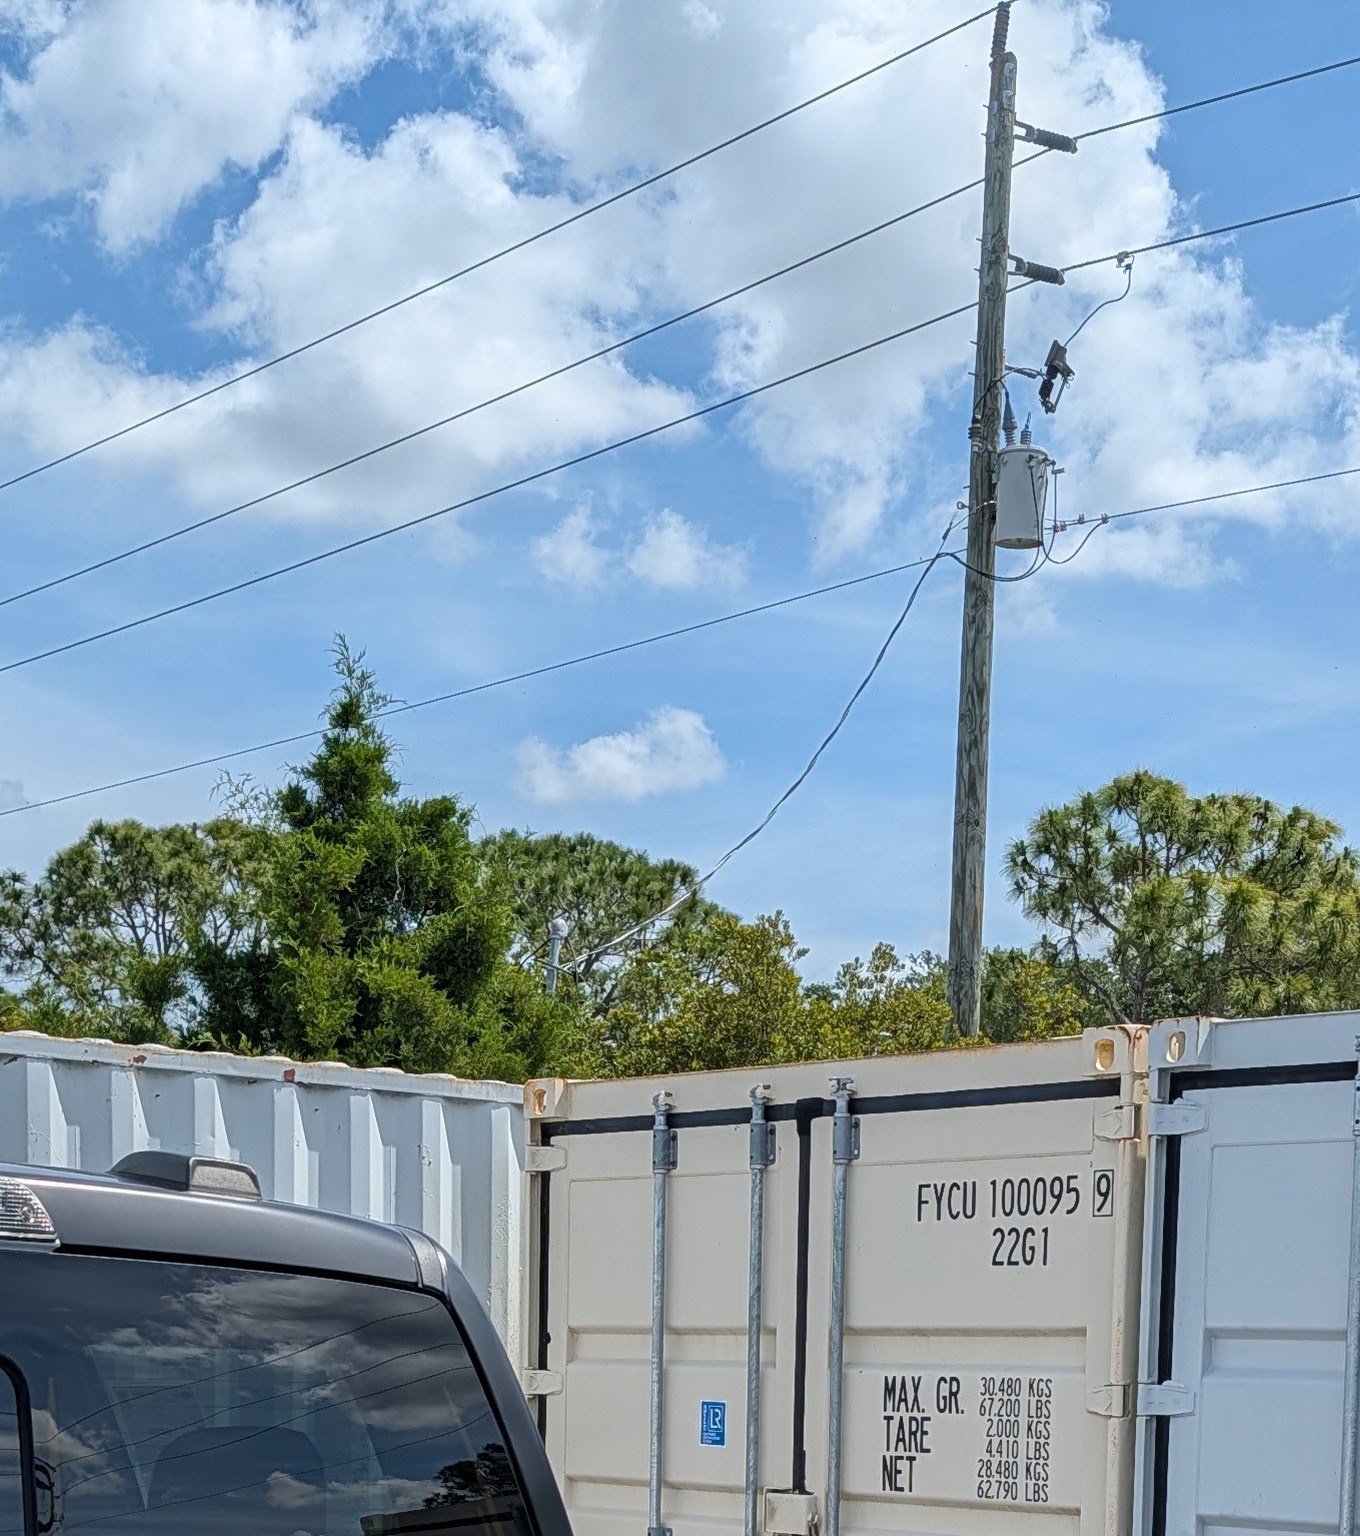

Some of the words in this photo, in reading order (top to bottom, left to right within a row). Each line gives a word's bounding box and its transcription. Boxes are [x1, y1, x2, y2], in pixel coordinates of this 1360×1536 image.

[917, 1180, 977, 1222] FYCU
[990, 1175, 1080, 1218] 100095
[1096, 1173, 1111, 1213] 9
[991, 1226, 1049, 1266] 22G1
[883, 1375, 925, 1413] MAX.
[936, 1376, 965, 1414] GR.
[1028, 1378, 1053, 1398] KGS
[1027, 1399, 1051, 1419] LBS
[883, 1415, 931, 1453] TARE
[1026, 1420, 1051, 1440] KGS
[1025, 1440, 1050, 1461] LBS
[882, 1455, 917, 1492] NET
[1025, 1461, 1049, 1482] KGS
[1024, 1482, 1049, 1503] LBS
